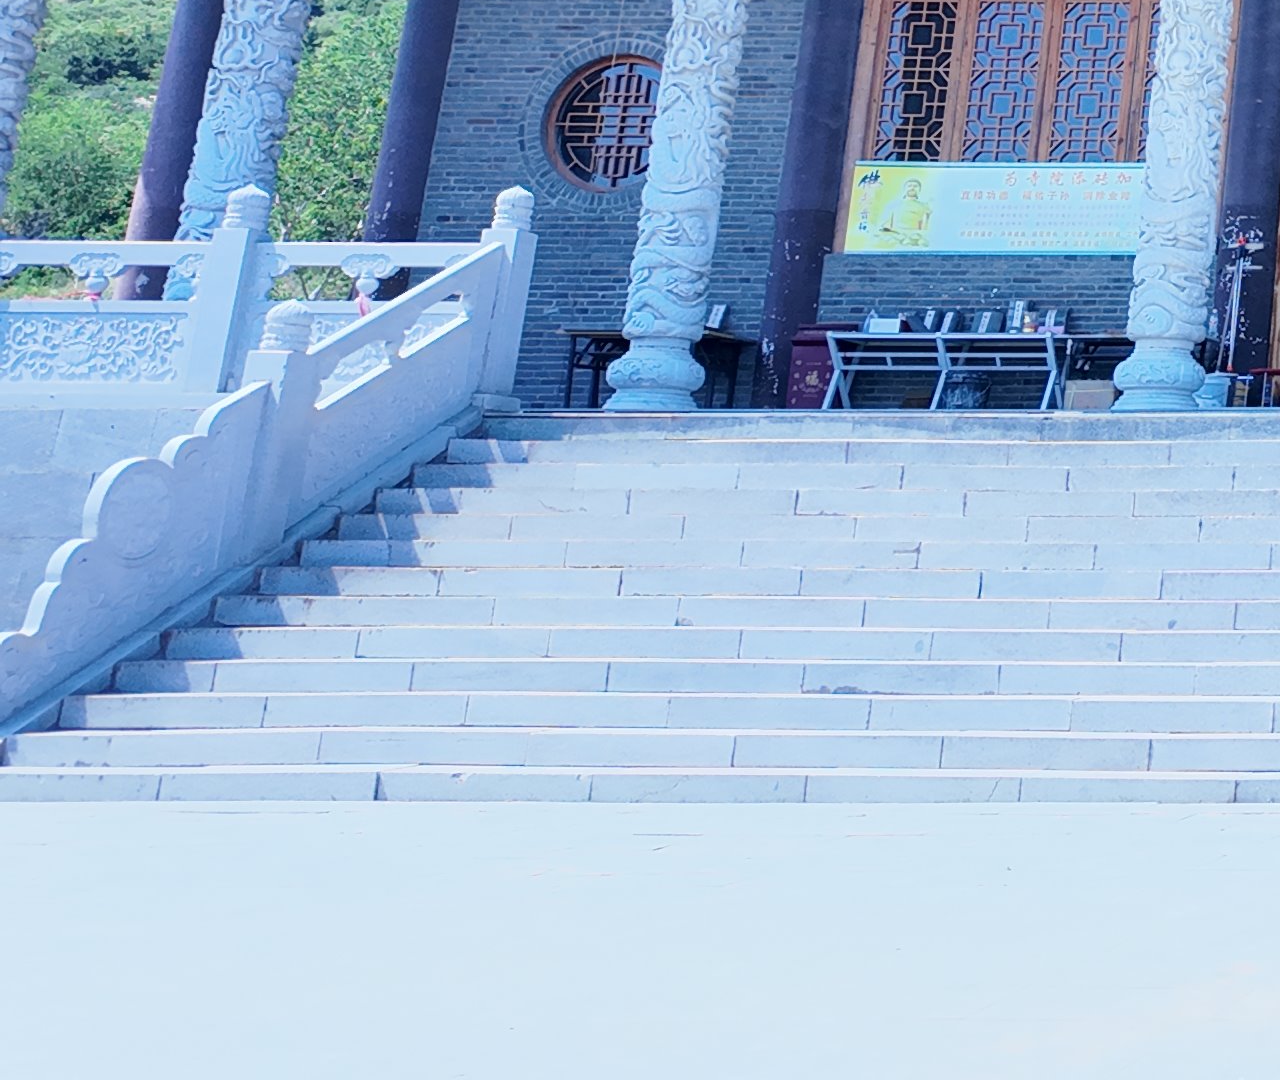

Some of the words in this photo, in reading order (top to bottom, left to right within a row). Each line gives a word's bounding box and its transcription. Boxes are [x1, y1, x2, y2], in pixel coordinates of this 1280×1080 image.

[1005, 171, 1144, 186] 为寺院添砖加
